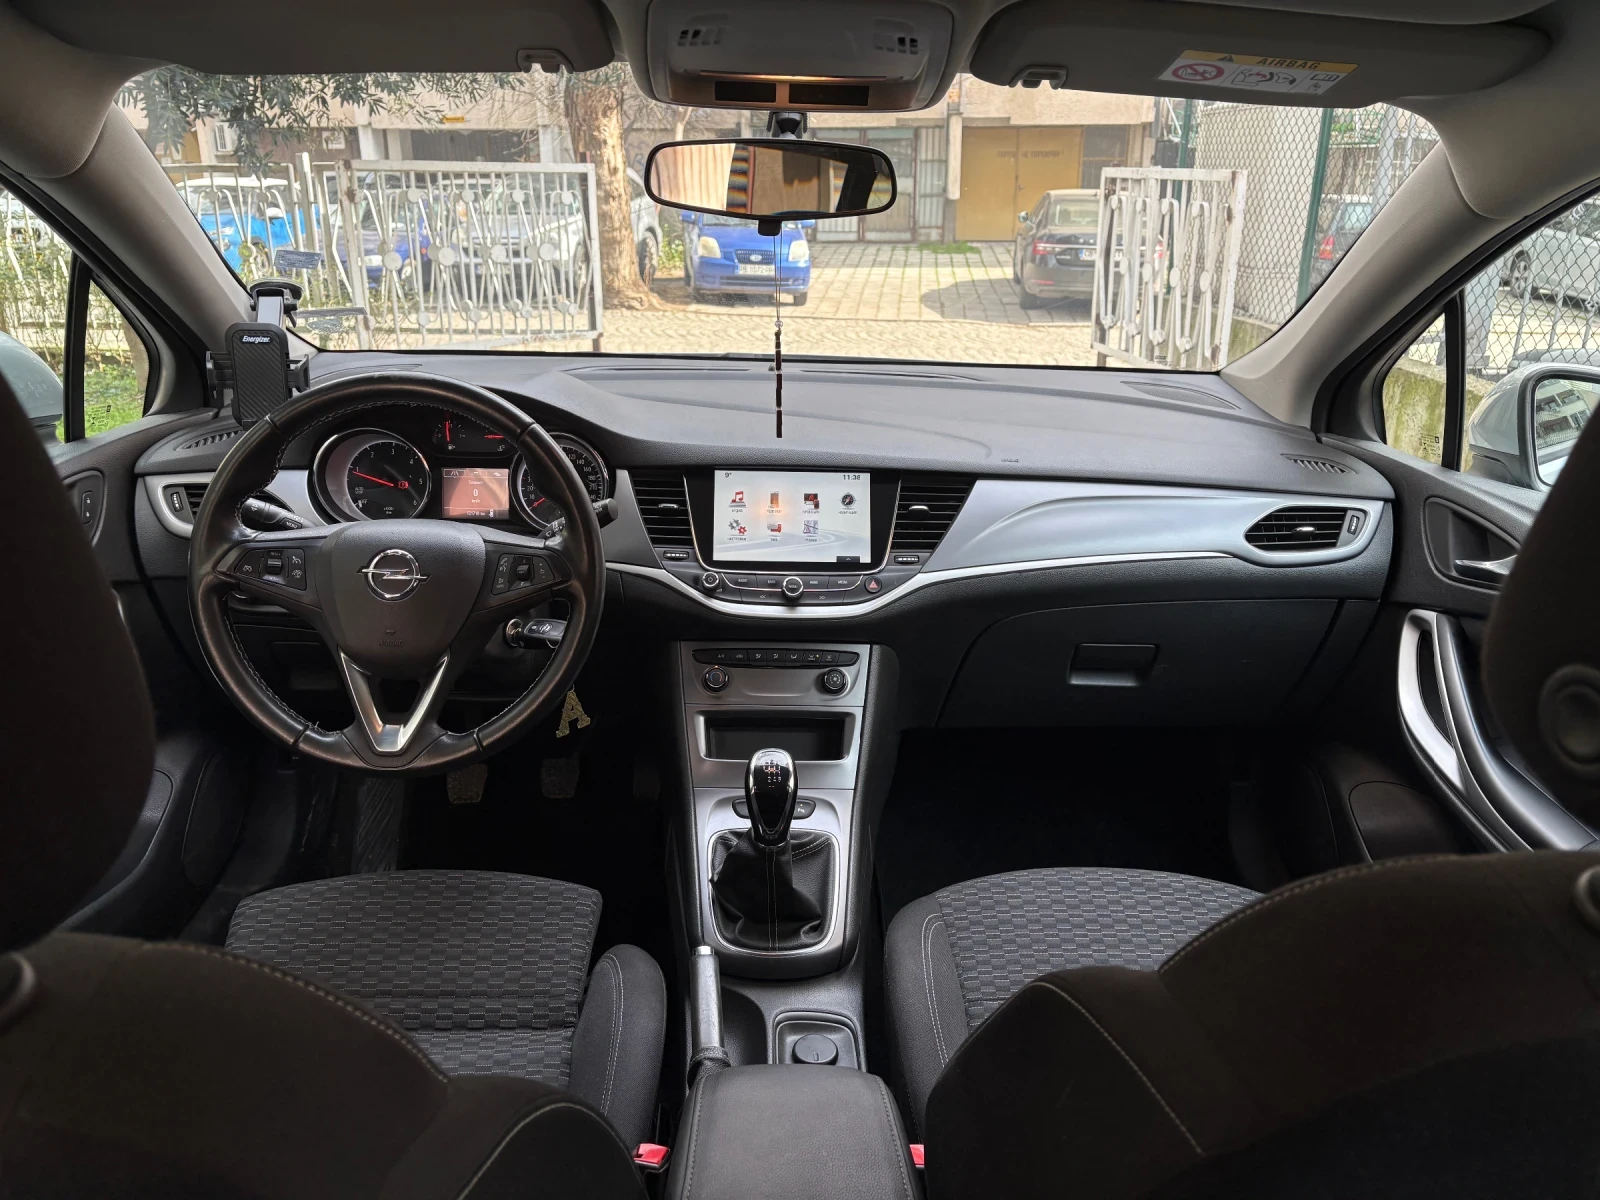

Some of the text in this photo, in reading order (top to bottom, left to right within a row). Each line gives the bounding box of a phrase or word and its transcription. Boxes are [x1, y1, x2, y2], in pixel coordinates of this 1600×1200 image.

[1256, 57, 1321, 70] AIRBAG
[242, 335, 271, 344] Energizer
[473, 488, 479, 497] 0
[556, 690, 591, 738] A
